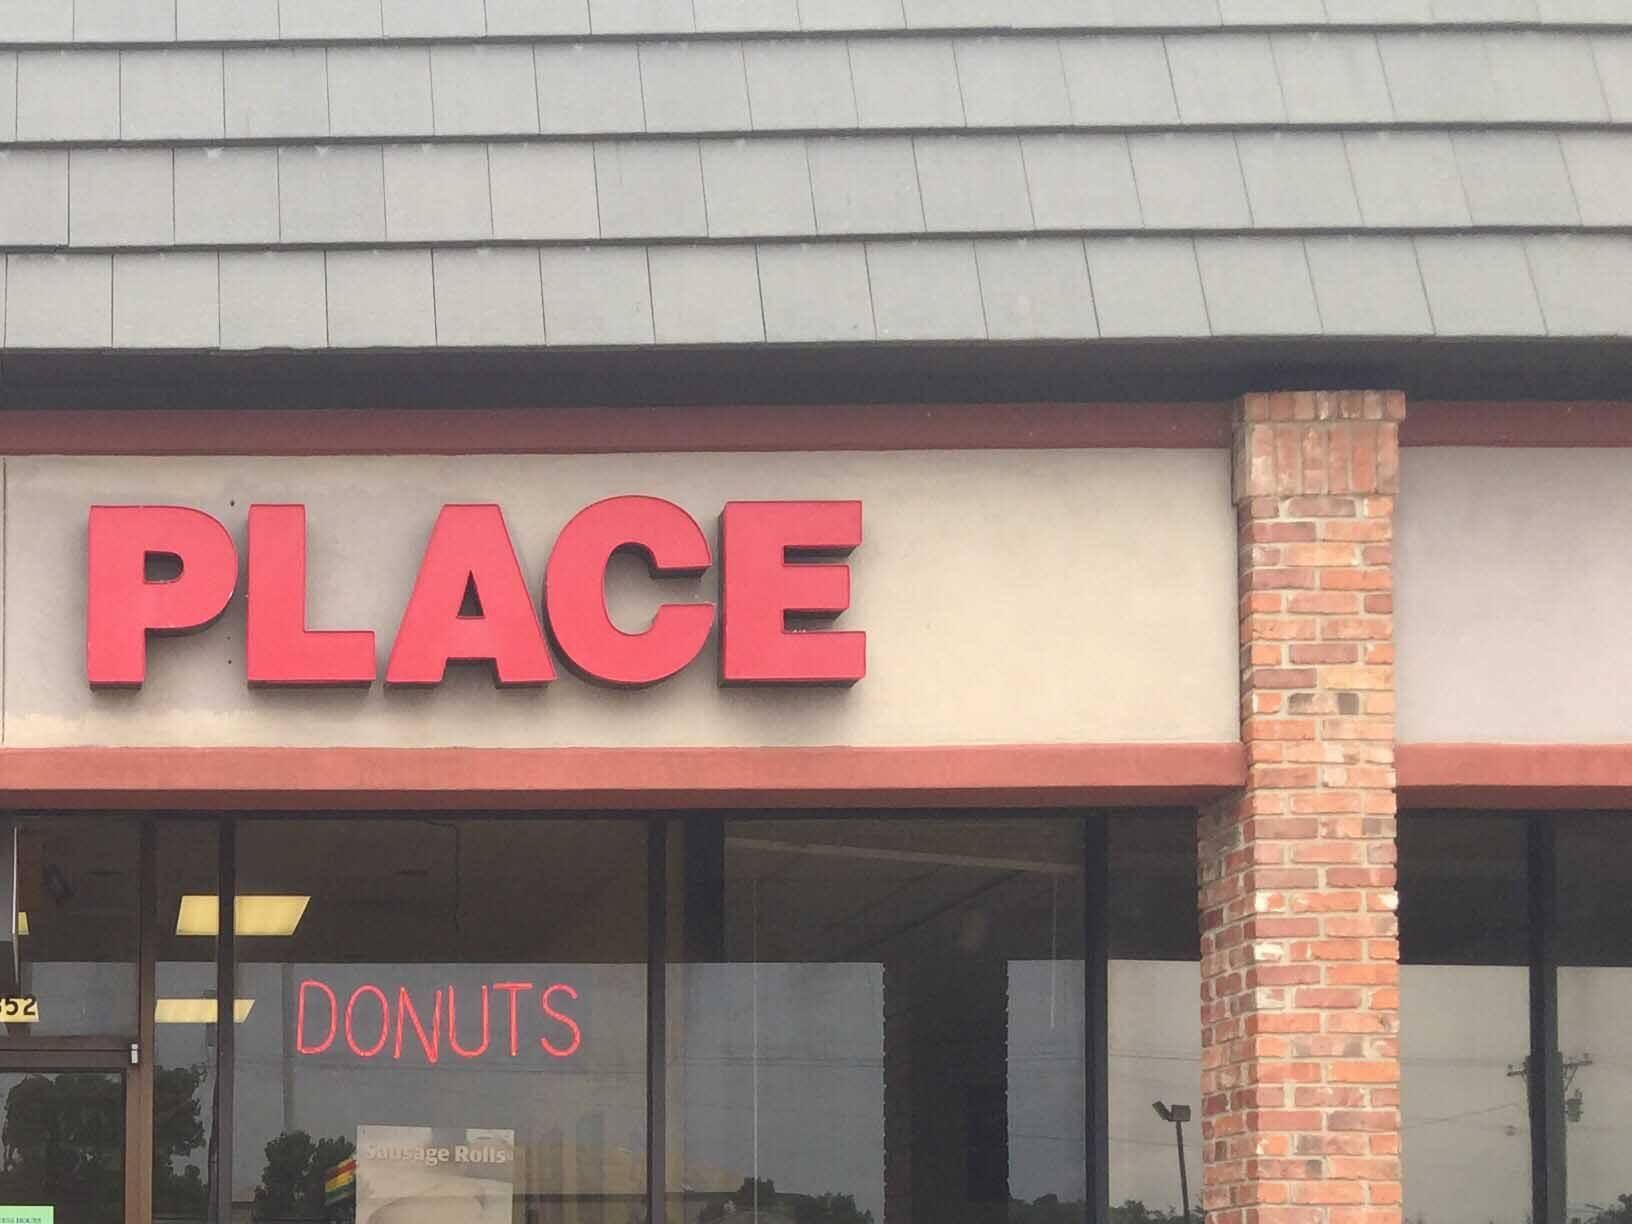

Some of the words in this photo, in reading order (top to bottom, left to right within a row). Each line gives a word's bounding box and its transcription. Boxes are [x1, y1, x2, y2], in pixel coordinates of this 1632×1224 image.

[86, 493, 866, 687] PLACE
[295, 979, 582, 1064] DONUTS
[367, 1144, 449, 1167] Sausage
[454, 1144, 507, 1164] Rolls
